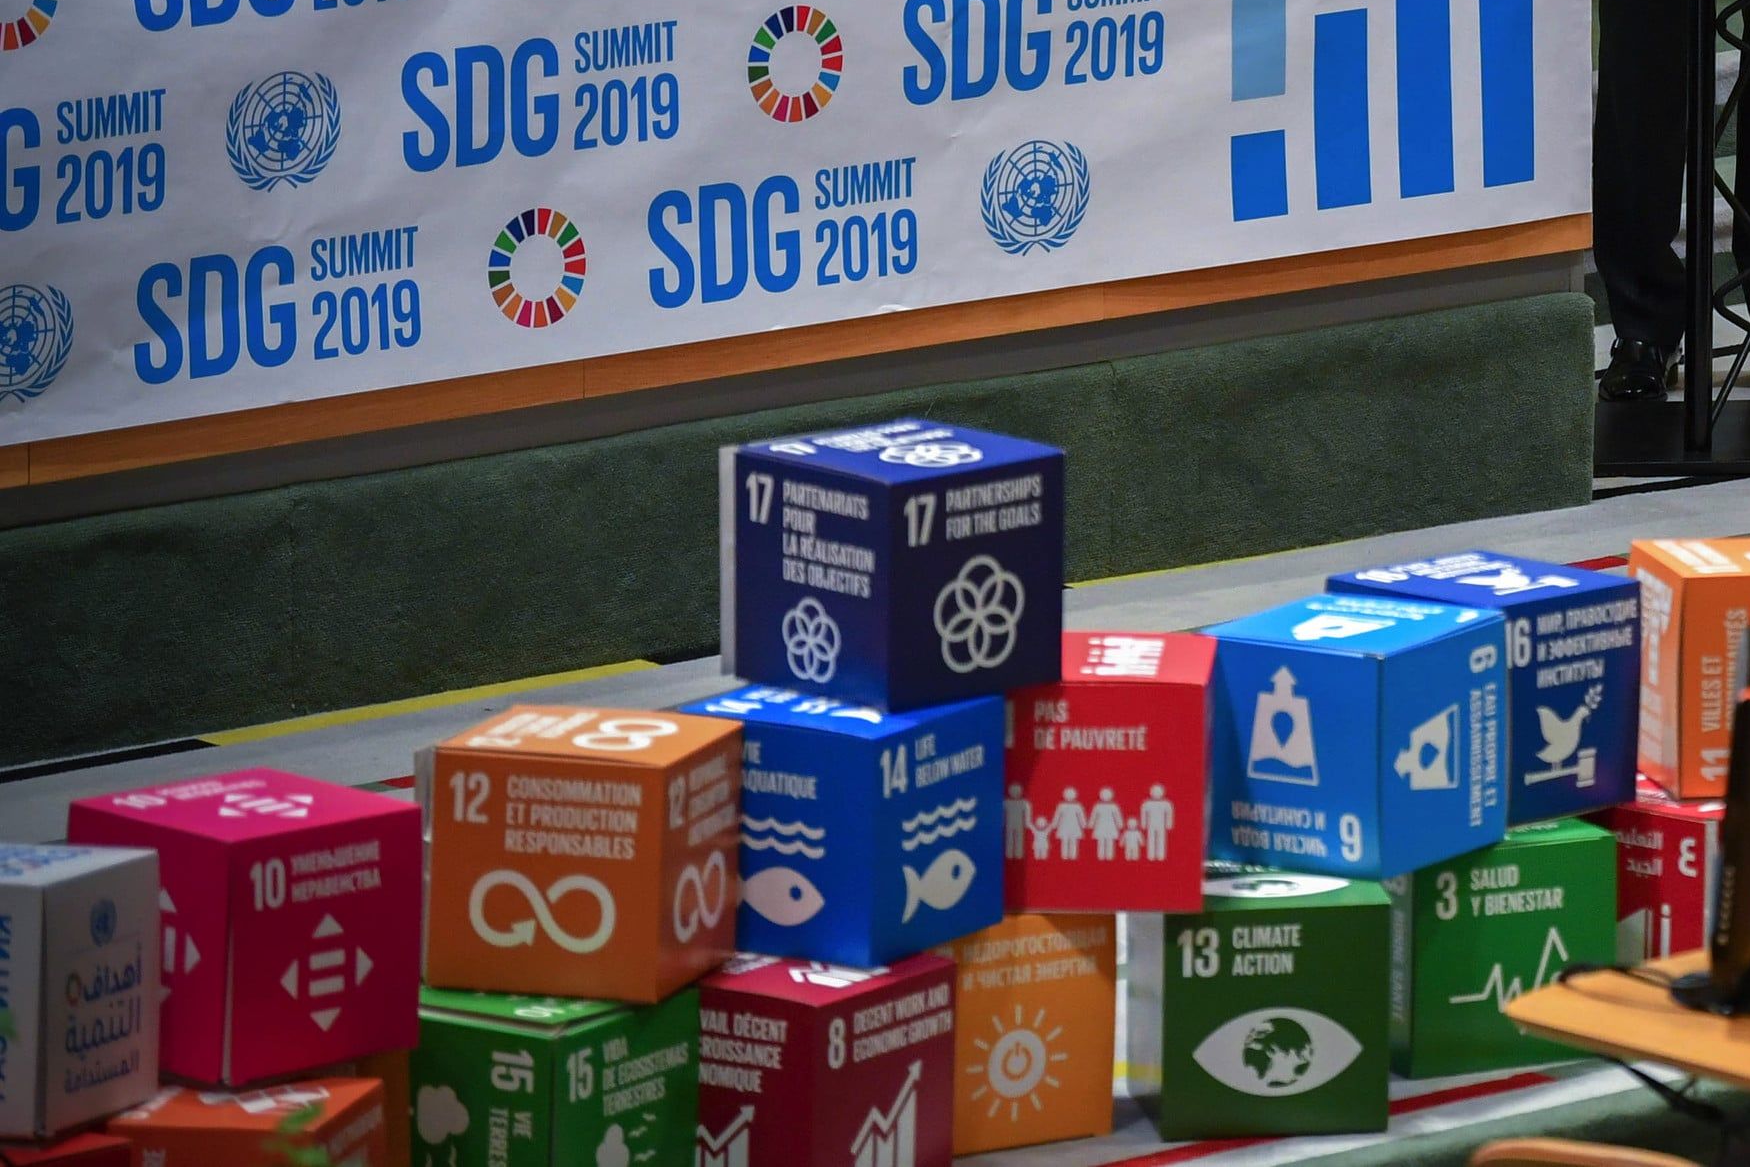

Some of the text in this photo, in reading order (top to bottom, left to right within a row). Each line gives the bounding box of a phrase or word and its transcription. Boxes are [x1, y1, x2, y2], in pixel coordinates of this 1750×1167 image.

[575, 20, 677, 73] SUMMIT
[1064, 10, 1165, 85] 2019
[57, 89, 166, 144] SUMMIT
[401, 38, 559, 172] SDG
[574, 73, 680, 150] 2019
[56, 143, 166, 224] 2019
[815, 157, 917, 210] SUMMIT
[311, 226, 418, 281] SUMMIT
[648, 175, 800, 309] SDG
[815, 208, 918, 286] 2019
[134, 245, 298, 384] SDG
[312, 280, 421, 360] 2019
[746, 472, 774, 525] 17
[782, 479, 870, 521] PARTENARIATS
[945, 473, 1042, 513] PARTNERSHIPS
[782, 505, 816, 534] POUR
[782, 531, 799, 557] LA
[904, 493, 937, 547] 17
[945, 502, 1042, 541] FOR THE GOALS
[782, 557, 871, 599] DES OBJECTIFS
[1469, 644, 1497, 673] 6
[1505, 617, 1532, 669] 16
[1034, 699, 1069, 723] PAS
[1701, 656, 1722, 732] VILLES ET
[915, 734, 936, 760] LIFE
[1034, 725, 1147, 751] DE PAUVRETÉ
[506, 775, 643, 807] CONSOMMATION
[880, 745, 908, 798] 14
[450, 771, 491, 824] 12
[505, 802, 638, 833] ET PRODUCTION
[504, 828, 635, 860] RESPONSABLES
[1339, 813, 1363, 863] 6
[250, 857, 286, 912] 10
[1436, 872, 1457, 920] 3
[1470, 864, 1519, 890] SALUD
[1471, 886, 1563, 917] Y BIENESTAR
[1177, 928, 1220, 978] 13
[1232, 924, 1302, 950] CLIMATE
[1232, 952, 1293, 977] ACTION
[733, 1013, 787, 1043] DÉCENT
[828, 1018, 846, 1069] 8
[491, 1049, 534, 1093] 15
[567, 1047, 593, 1103] 15
